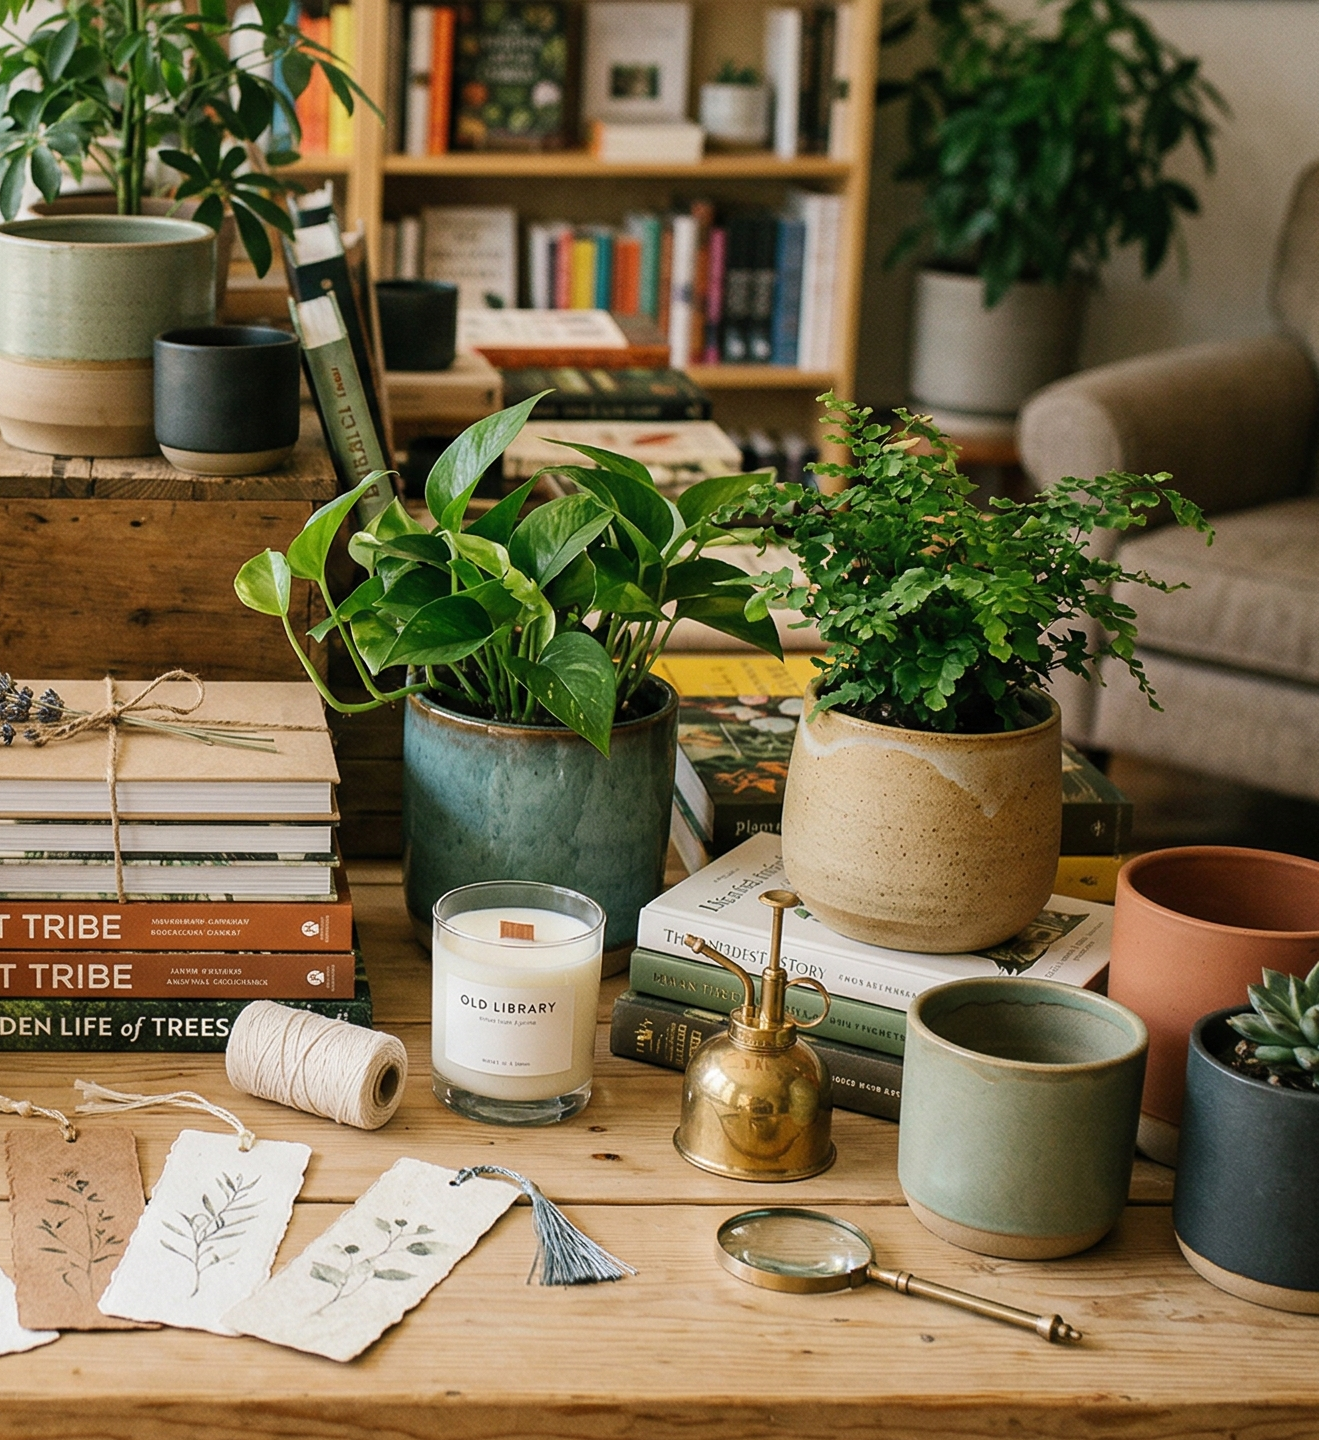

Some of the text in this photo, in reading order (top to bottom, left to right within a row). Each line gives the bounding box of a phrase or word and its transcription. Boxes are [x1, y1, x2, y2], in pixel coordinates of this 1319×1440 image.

[22, 914, 122, 940] TRIBE
[28, 963, 133, 990] TRIBE
[781, 956, 827, 980] STORY
[460, 994, 557, 1015] OLD LIBRARY
[60, 1016, 112, 1036] LIFE
[120, 1016, 147, 1043] of
[151, 1017, 230, 1037] TREES
